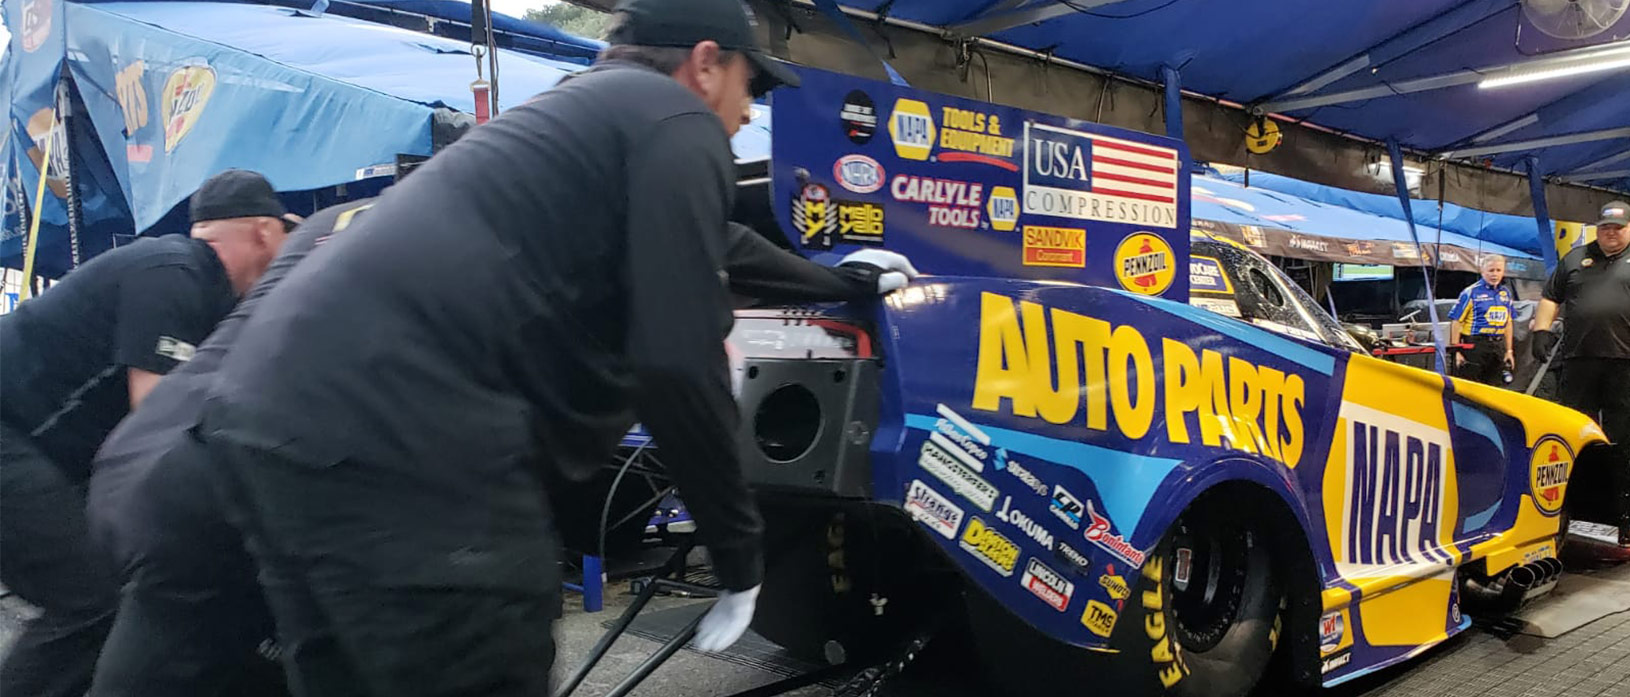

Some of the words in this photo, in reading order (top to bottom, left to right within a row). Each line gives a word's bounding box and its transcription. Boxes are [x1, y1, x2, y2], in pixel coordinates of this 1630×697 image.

[942, 106, 985, 133] TOOLS
[988, 115, 1001, 135] &
[940, 127, 1015, 157] EQUIPMENT
[1034, 138, 1088, 181] USA
[892, 175, 982, 207] CARLYLE
[929, 206, 980, 228] TOOLS
[1026, 190, 1175, 224] COMPRESSION
[1026, 228, 1083, 248] SANDVIK
[1123, 252, 1168, 277] PENNZOIL
[971, 291, 1156, 440] AUTO
[1162, 337, 1305, 470] PARTS
[1536, 462, 1569, 488] PENNZOIL
[1348, 420, 1453, 565] NAPA
[1029, 561, 1067, 594] LINCOLN
[1088, 605, 1114, 628] TMS
[1142, 555, 1183, 688] EAGLE
